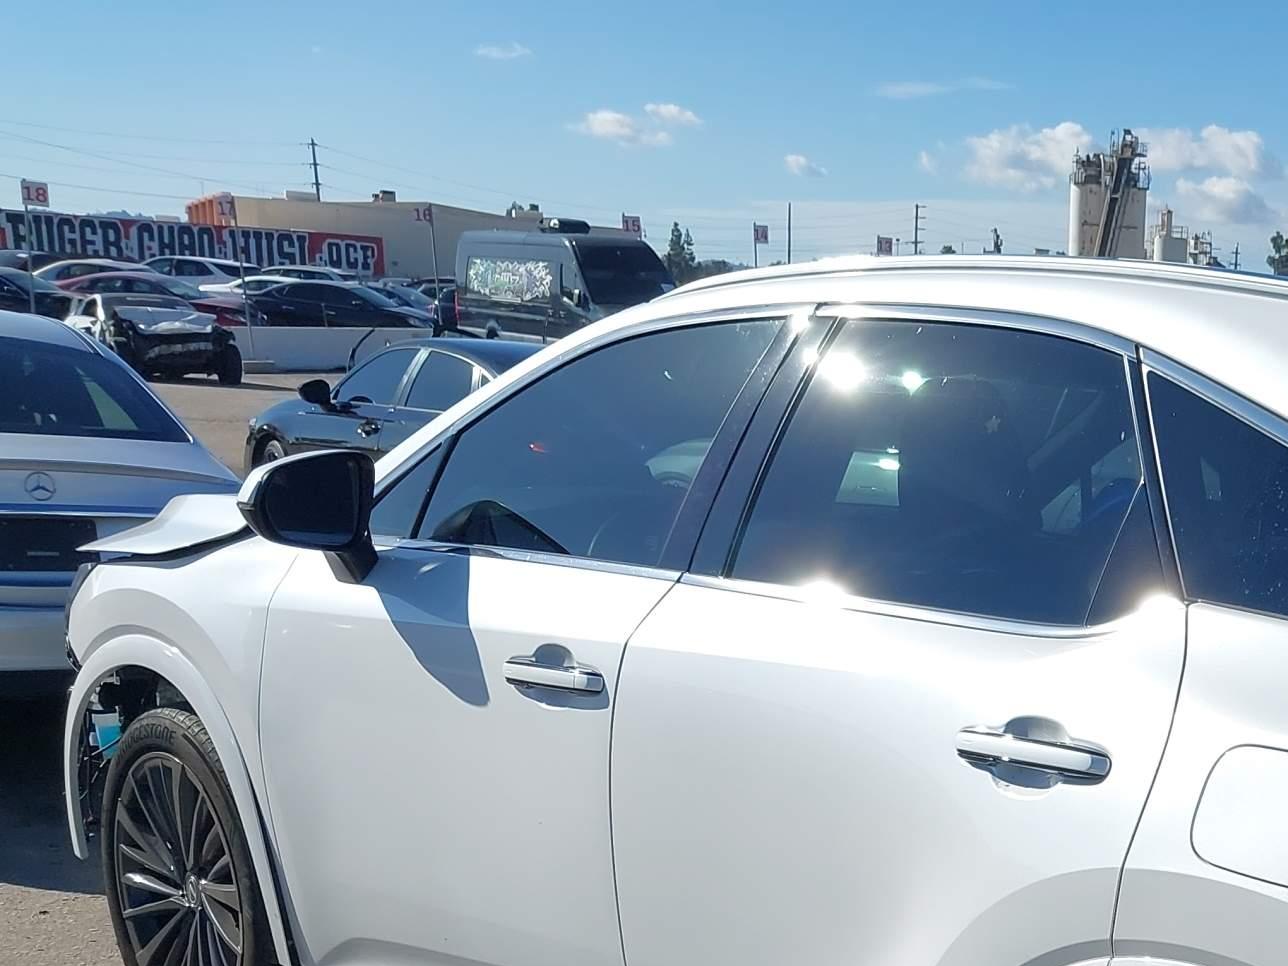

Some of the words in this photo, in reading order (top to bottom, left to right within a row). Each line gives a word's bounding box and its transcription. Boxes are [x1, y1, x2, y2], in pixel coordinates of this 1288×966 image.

[23, 186, 48, 203] 18
[413, 208, 433, 222] 16
[623, 218, 641, 233] 15
[755, 228, 768, 241] 14
